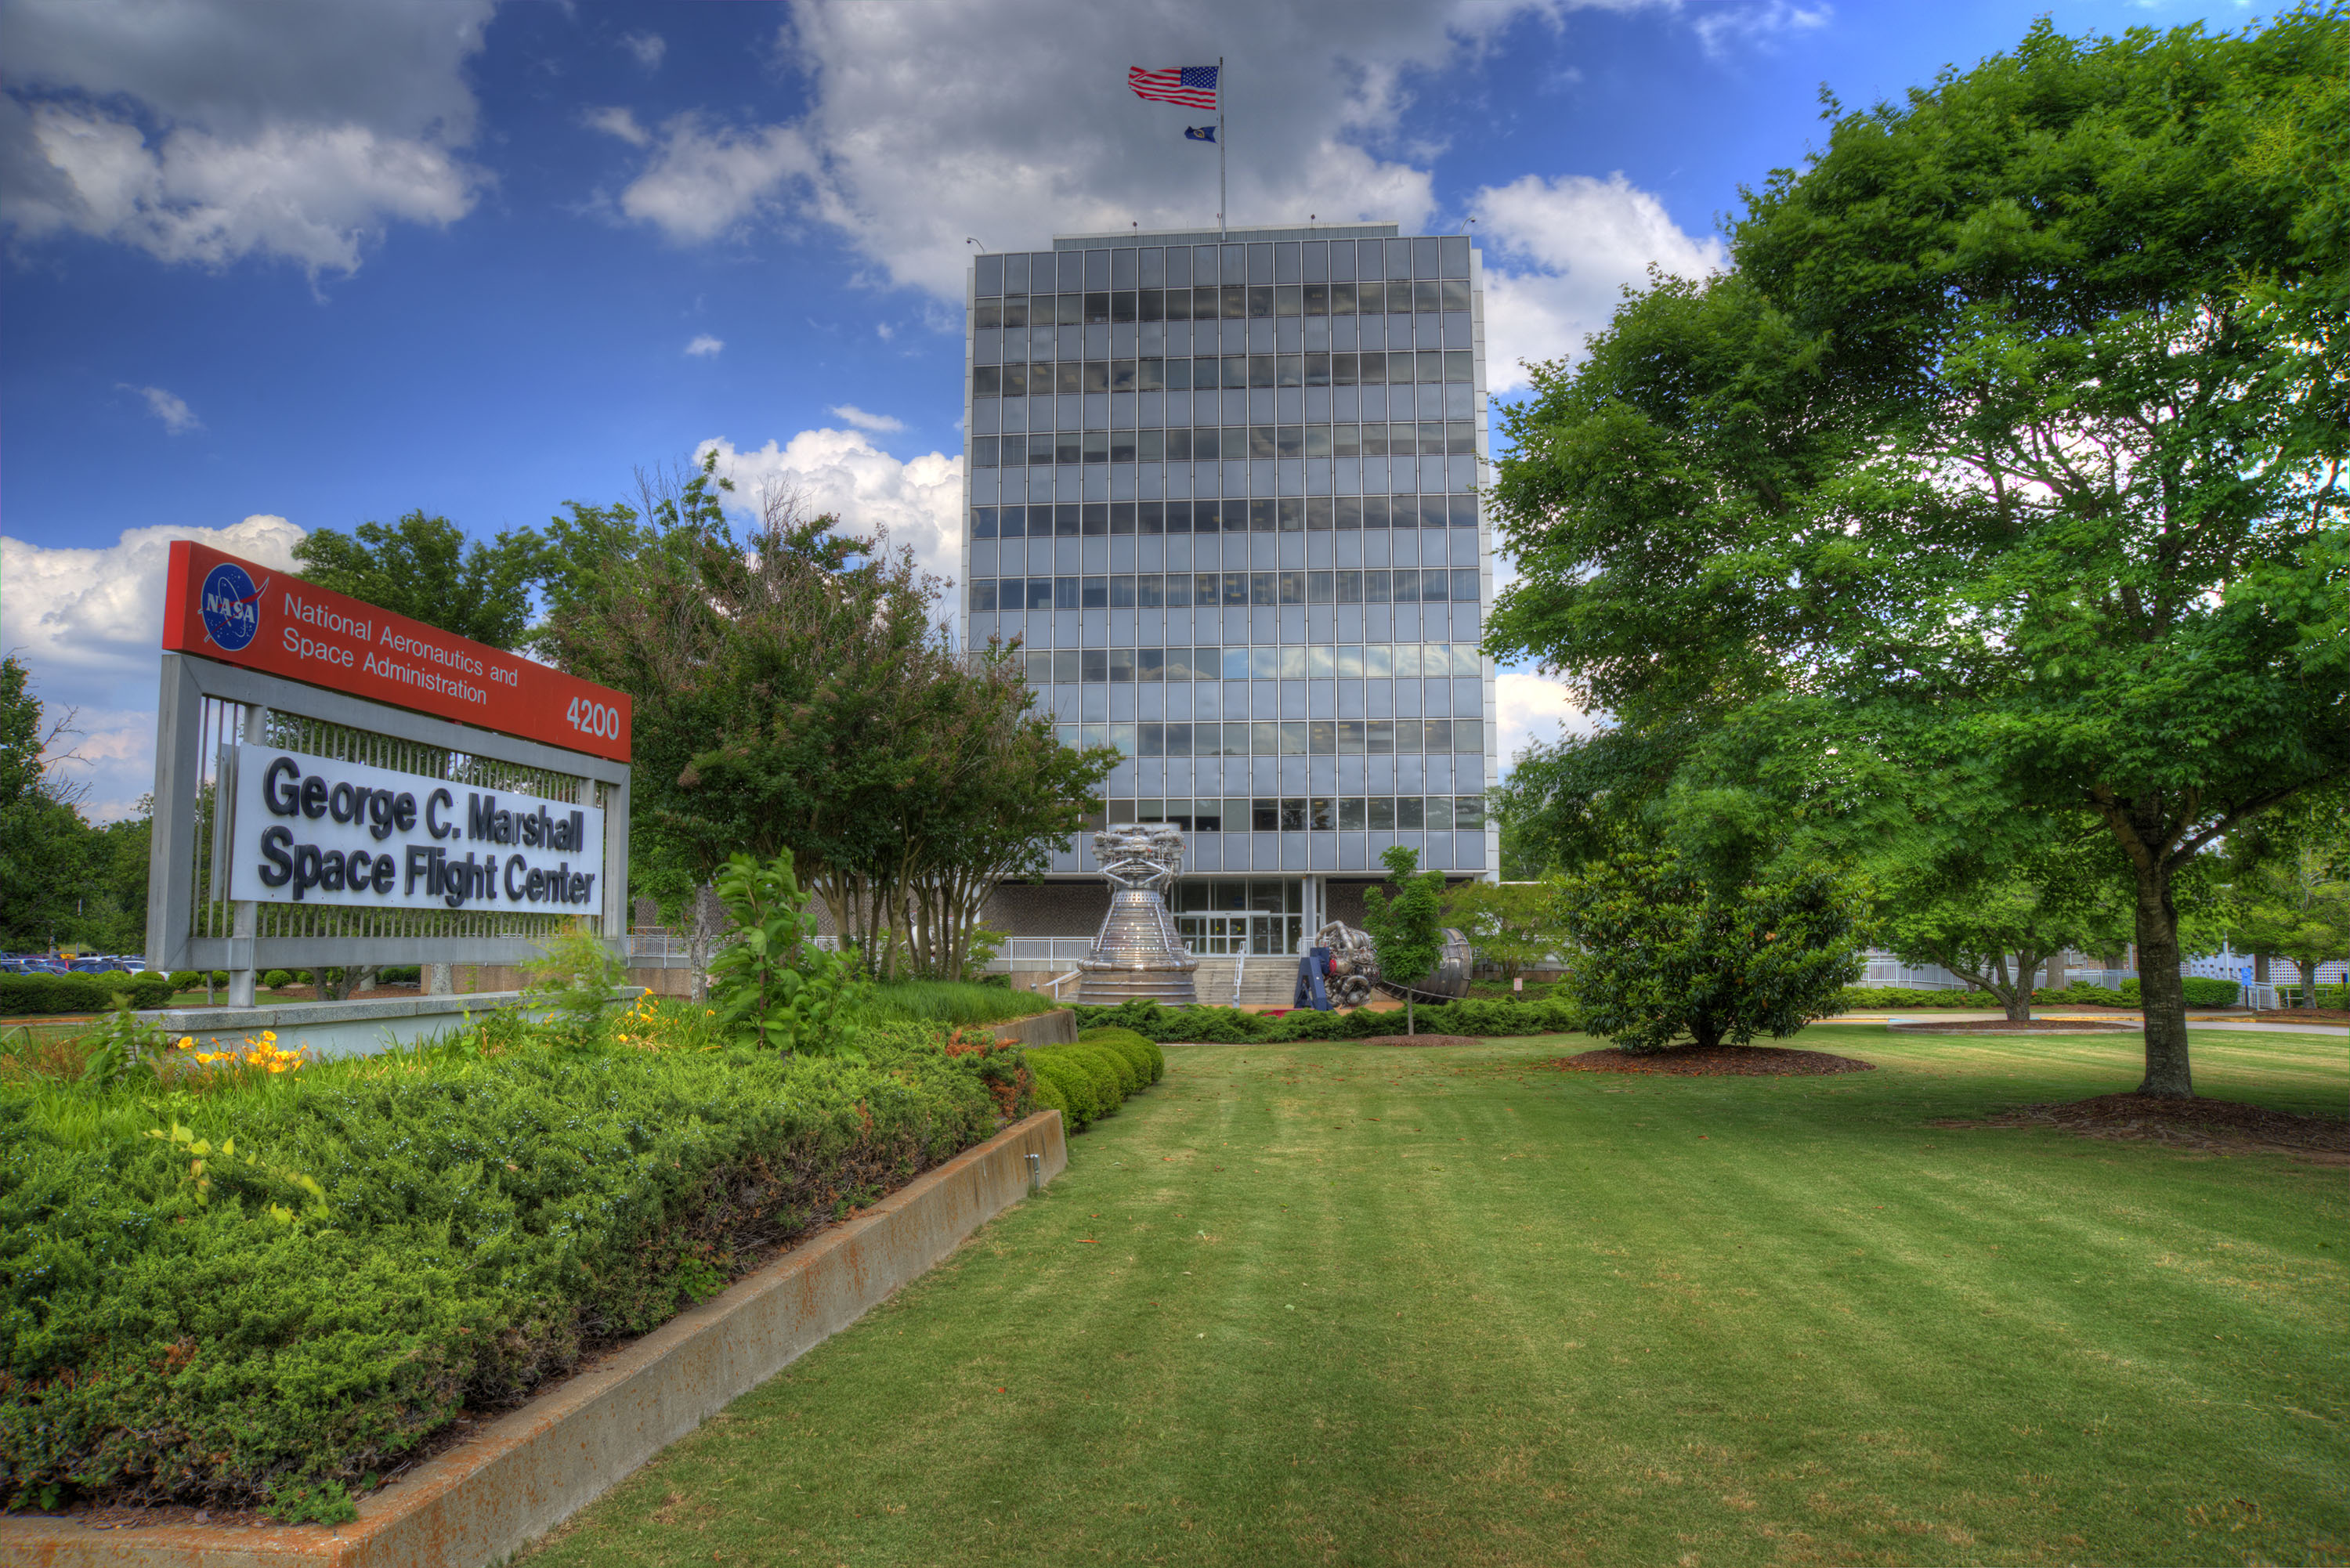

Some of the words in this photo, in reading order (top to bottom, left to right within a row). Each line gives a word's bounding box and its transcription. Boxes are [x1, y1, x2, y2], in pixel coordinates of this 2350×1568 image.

[207, 593, 255, 624] NASA
[284, 593, 372, 641] National
[380, 626, 483, 676] Aeronautics
[490, 663, 518, 686] and
[283, 628, 354, 667] Space
[363, 652, 486, 705] Administration
[566, 696, 620, 741] 4200
[264, 757, 416, 840] George
[426, 788, 461, 839] C.
[469, 793, 584, 853] Marshall
[259, 826, 396, 901] Space
[405, 845, 497, 907] Flight
[504, 854, 595, 904] Center
